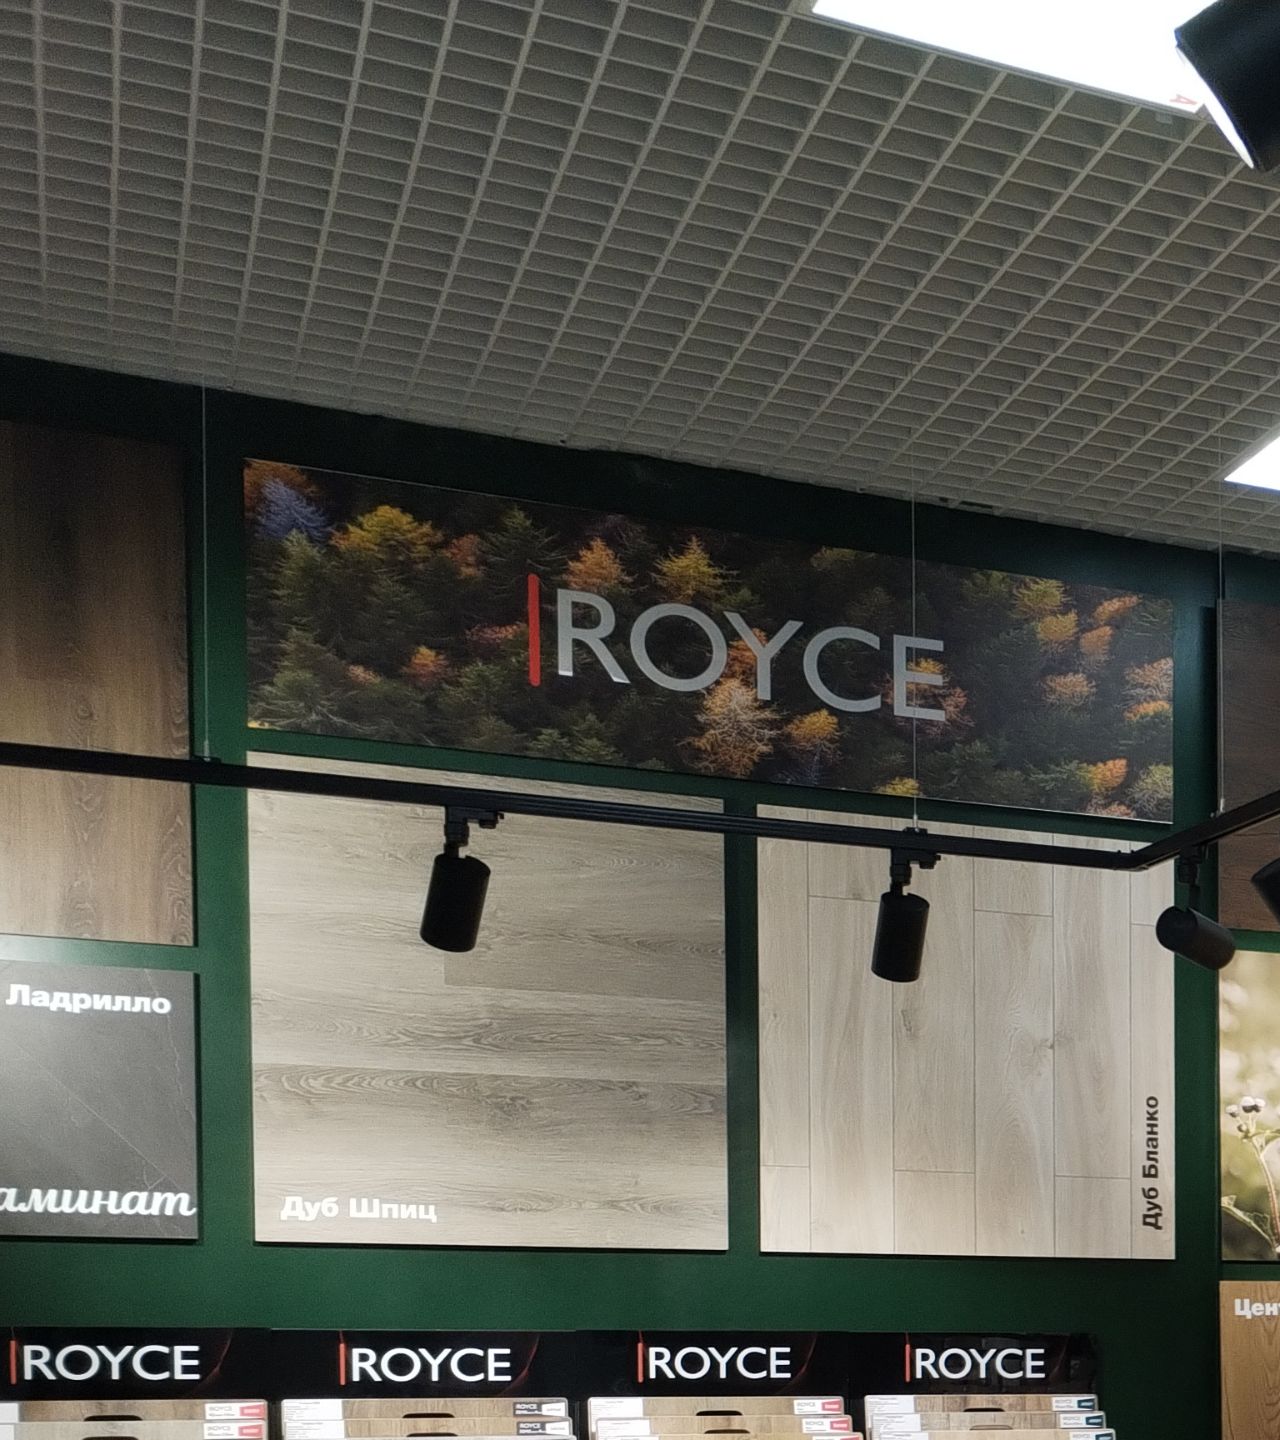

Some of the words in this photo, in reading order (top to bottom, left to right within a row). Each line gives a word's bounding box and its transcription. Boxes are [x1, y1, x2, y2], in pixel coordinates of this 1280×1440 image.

[556, 586, 947, 723] ROYCE
[9, 983, 172, 1015] Ладрилло
[1141, 1095, 1160, 1180] Бланко
[280, 1195, 339, 1223] Дуб
[349, 1198, 437, 1224] Шпиц
[1141, 1186, 1162, 1231] Дуб
[22, 1344, 201, 1381] ROYCE
[351, 1347, 512, 1383] ROYCE
[647, 1346, 792, 1380] ROYCE
[914, 1348, 1046, 1380] ROYCE
